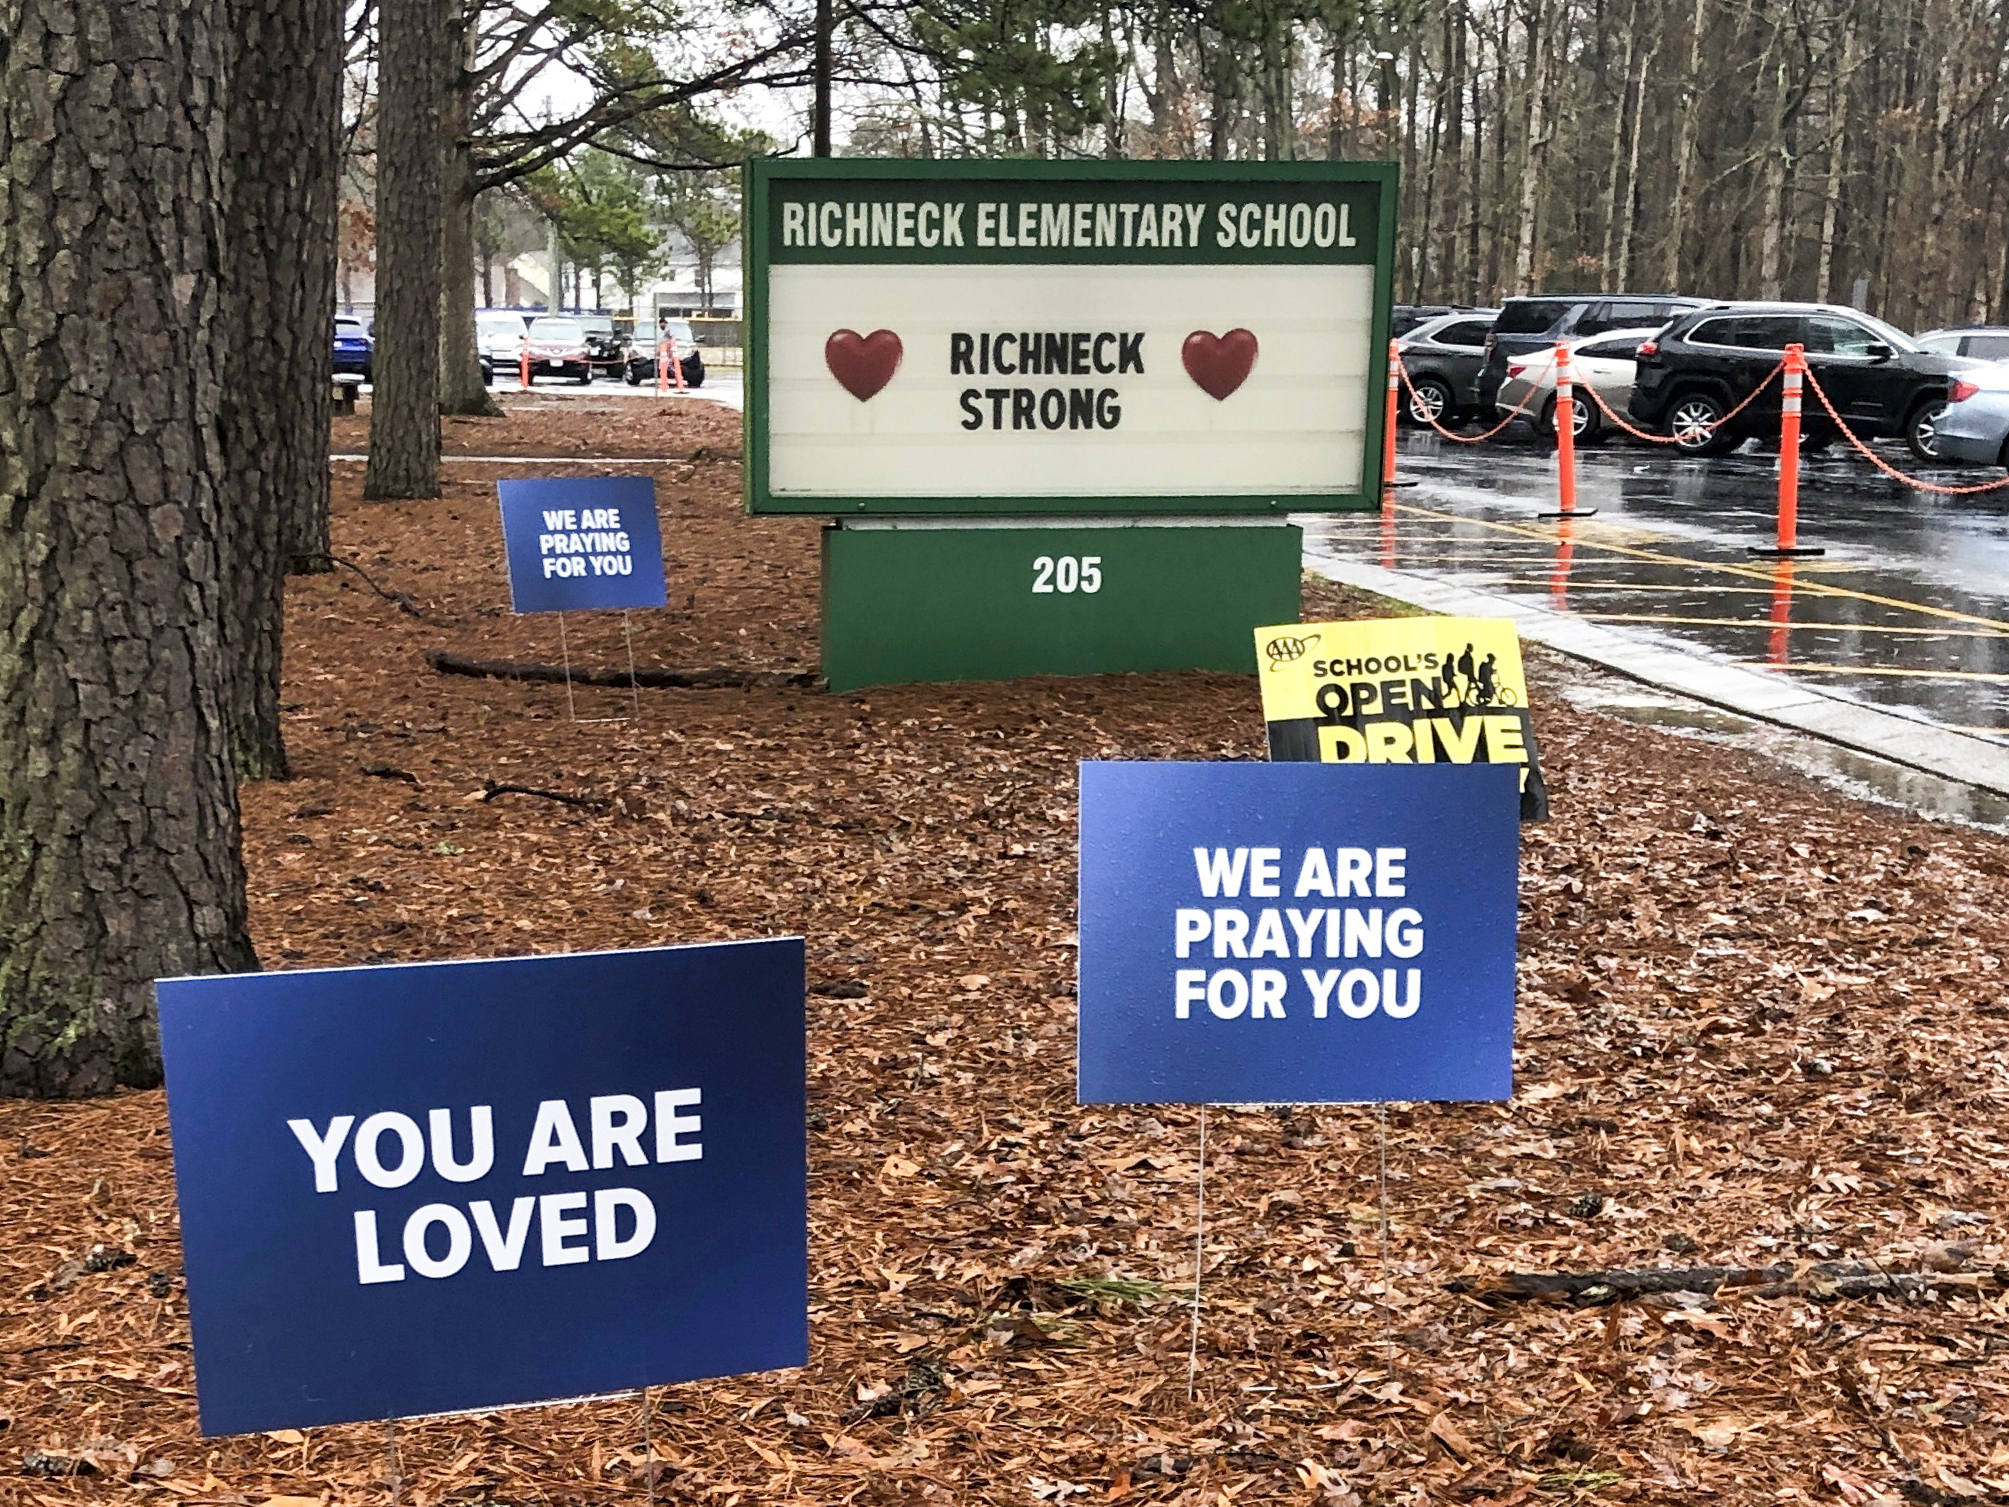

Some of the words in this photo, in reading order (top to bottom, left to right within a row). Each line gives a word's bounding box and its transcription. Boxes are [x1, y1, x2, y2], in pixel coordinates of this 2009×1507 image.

[783, 202, 965, 248] RICHNECK
[976, 202, 1206, 248] ELEMENTARY
[1216, 202, 1357, 248] SCHOOL
[950, 331, 1146, 376] RICHNECK
[959, 387, 1122, 431] STRONG
[542, 509, 578, 532] WE
[580, 508, 621, 531] ARE
[539, 531, 631, 555] PRAYING
[542, 556, 588, 579] FOR
[589, 554, 633, 577] YOU
[1031, 555, 1102, 594] 205
[1269, 638, 1304, 661] AAA
[1313, 652, 1440, 678] SCHOOL'S
[1316, 676, 1444, 717] OPEN
[1317, 715, 1529, 764] DRIVE
[1192, 846, 1282, 898] WE
[1294, 847, 1407, 898] ARE
[1174, 907, 1424, 959] PRAYING
[1175, 968, 1288, 1020] FOR
[1301, 967, 1422, 1019] YOU
[286, 1105, 495, 1193] YOU
[522, 1087, 703, 1176] ARE
[353, 1187, 657, 1285] LOVED
